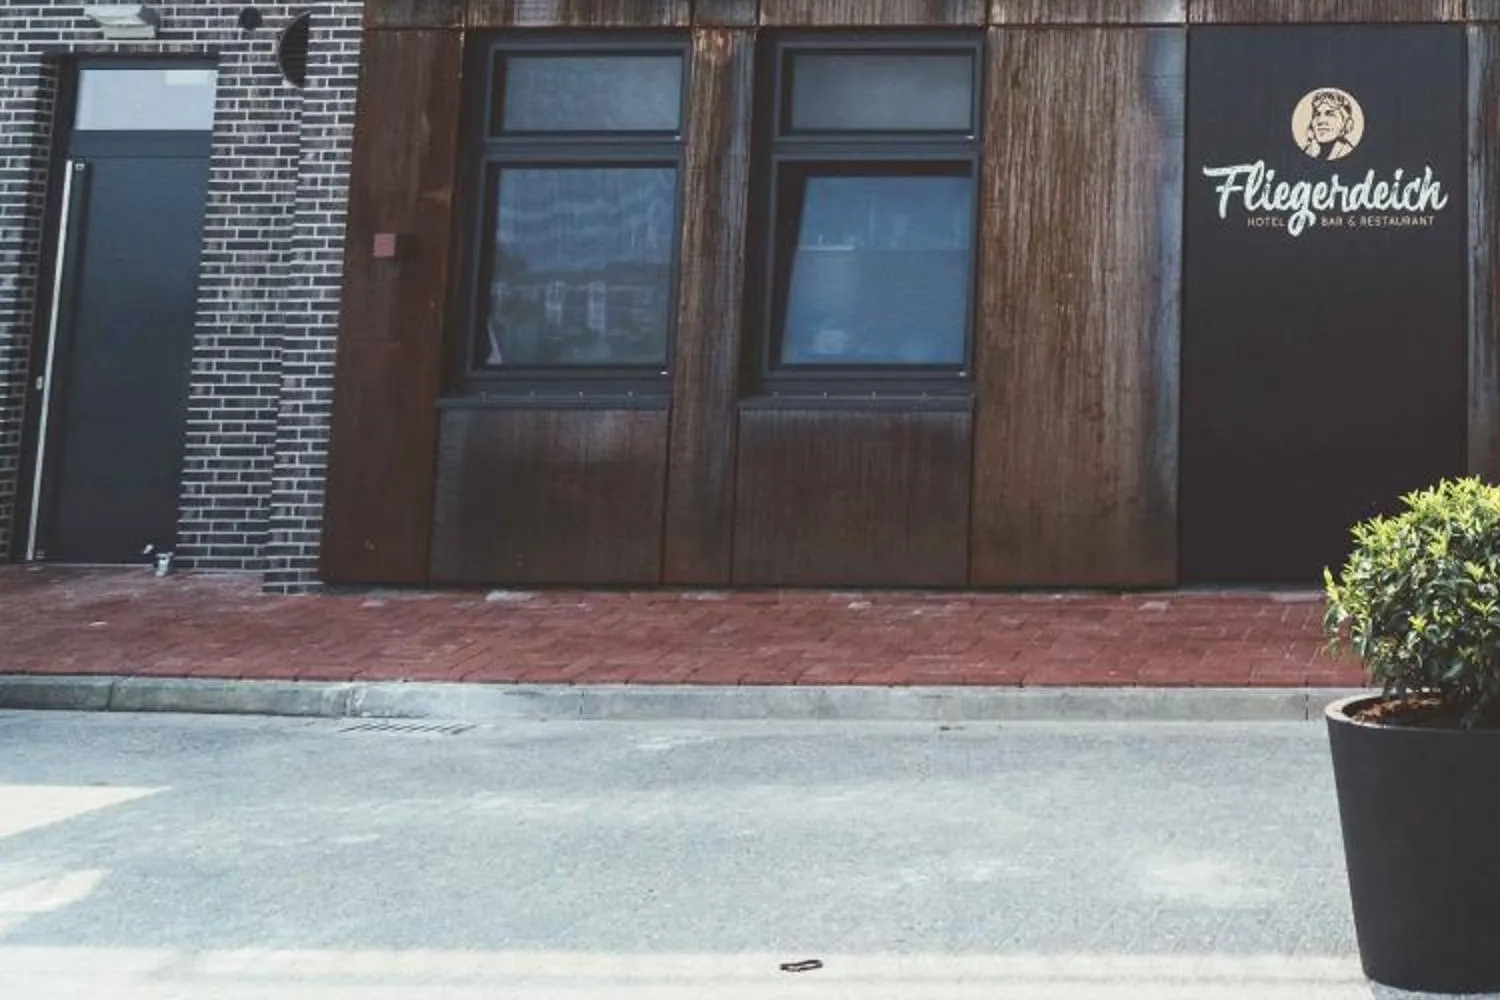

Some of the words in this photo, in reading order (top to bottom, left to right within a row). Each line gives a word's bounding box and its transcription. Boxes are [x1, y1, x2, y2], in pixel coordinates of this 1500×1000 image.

[1203, 160, 1448, 237] Fliegerdeich
[1247, 216, 1285, 228] HOTEL
[1321, 215, 1343, 227] BAR
[1347, 216, 1357, 227] &
[1360, 215, 1435, 227] RESTAURANT
